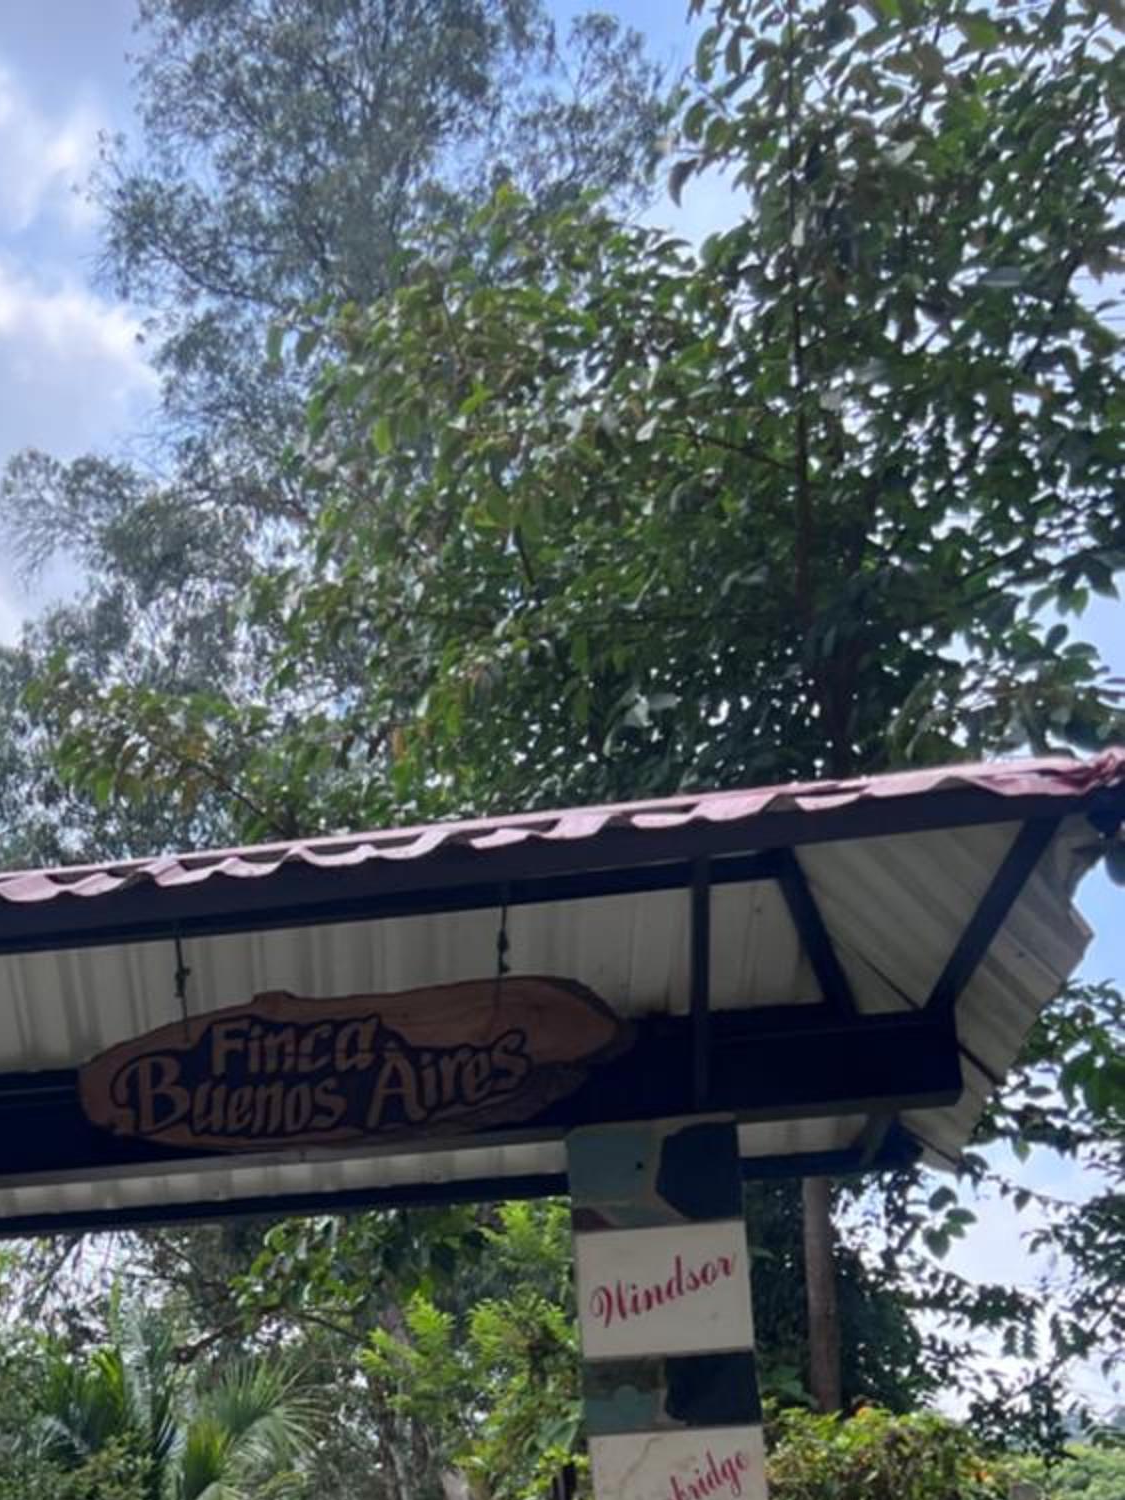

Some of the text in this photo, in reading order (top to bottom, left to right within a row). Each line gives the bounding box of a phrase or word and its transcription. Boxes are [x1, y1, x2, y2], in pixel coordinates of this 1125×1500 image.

[209, 1014, 379, 1077] Finca
[111, 1030, 532, 1136] Buenos Aires
[590, 1254, 738, 1328] Windsor
